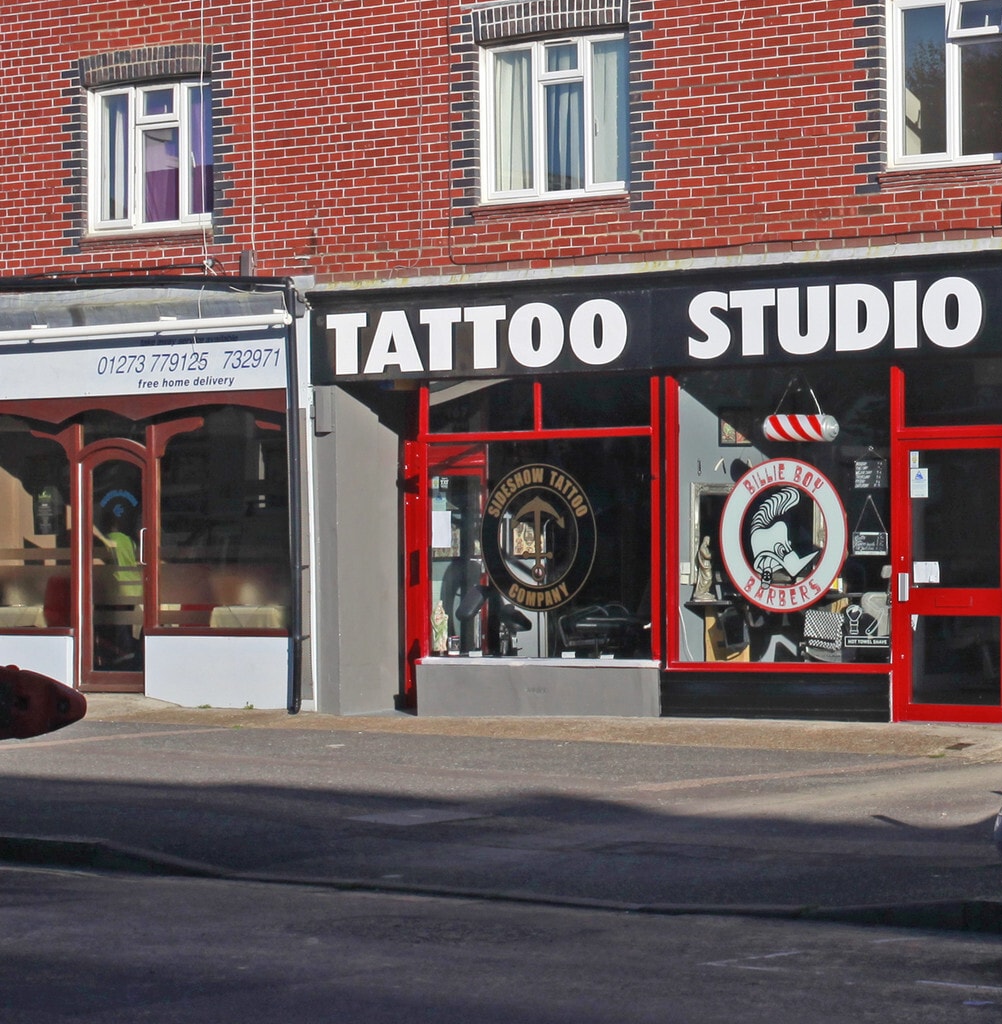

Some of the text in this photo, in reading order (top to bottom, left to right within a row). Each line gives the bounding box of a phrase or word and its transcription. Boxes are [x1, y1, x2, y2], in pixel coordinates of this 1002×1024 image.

[326, 276, 983, 375] TATTOO STUDIO
[97, 348, 281, 375] 01273 779125 732971
[138, 376, 235, 389] free home delivery
[488, 468, 588, 518] SIDESHOW TATTOO
[743, 463, 785, 495] BILLIE
[793, 465, 824, 492] BOY
[508, 582, 569, 608] COMPANY
[743, 576, 822, 607] BARBERS
